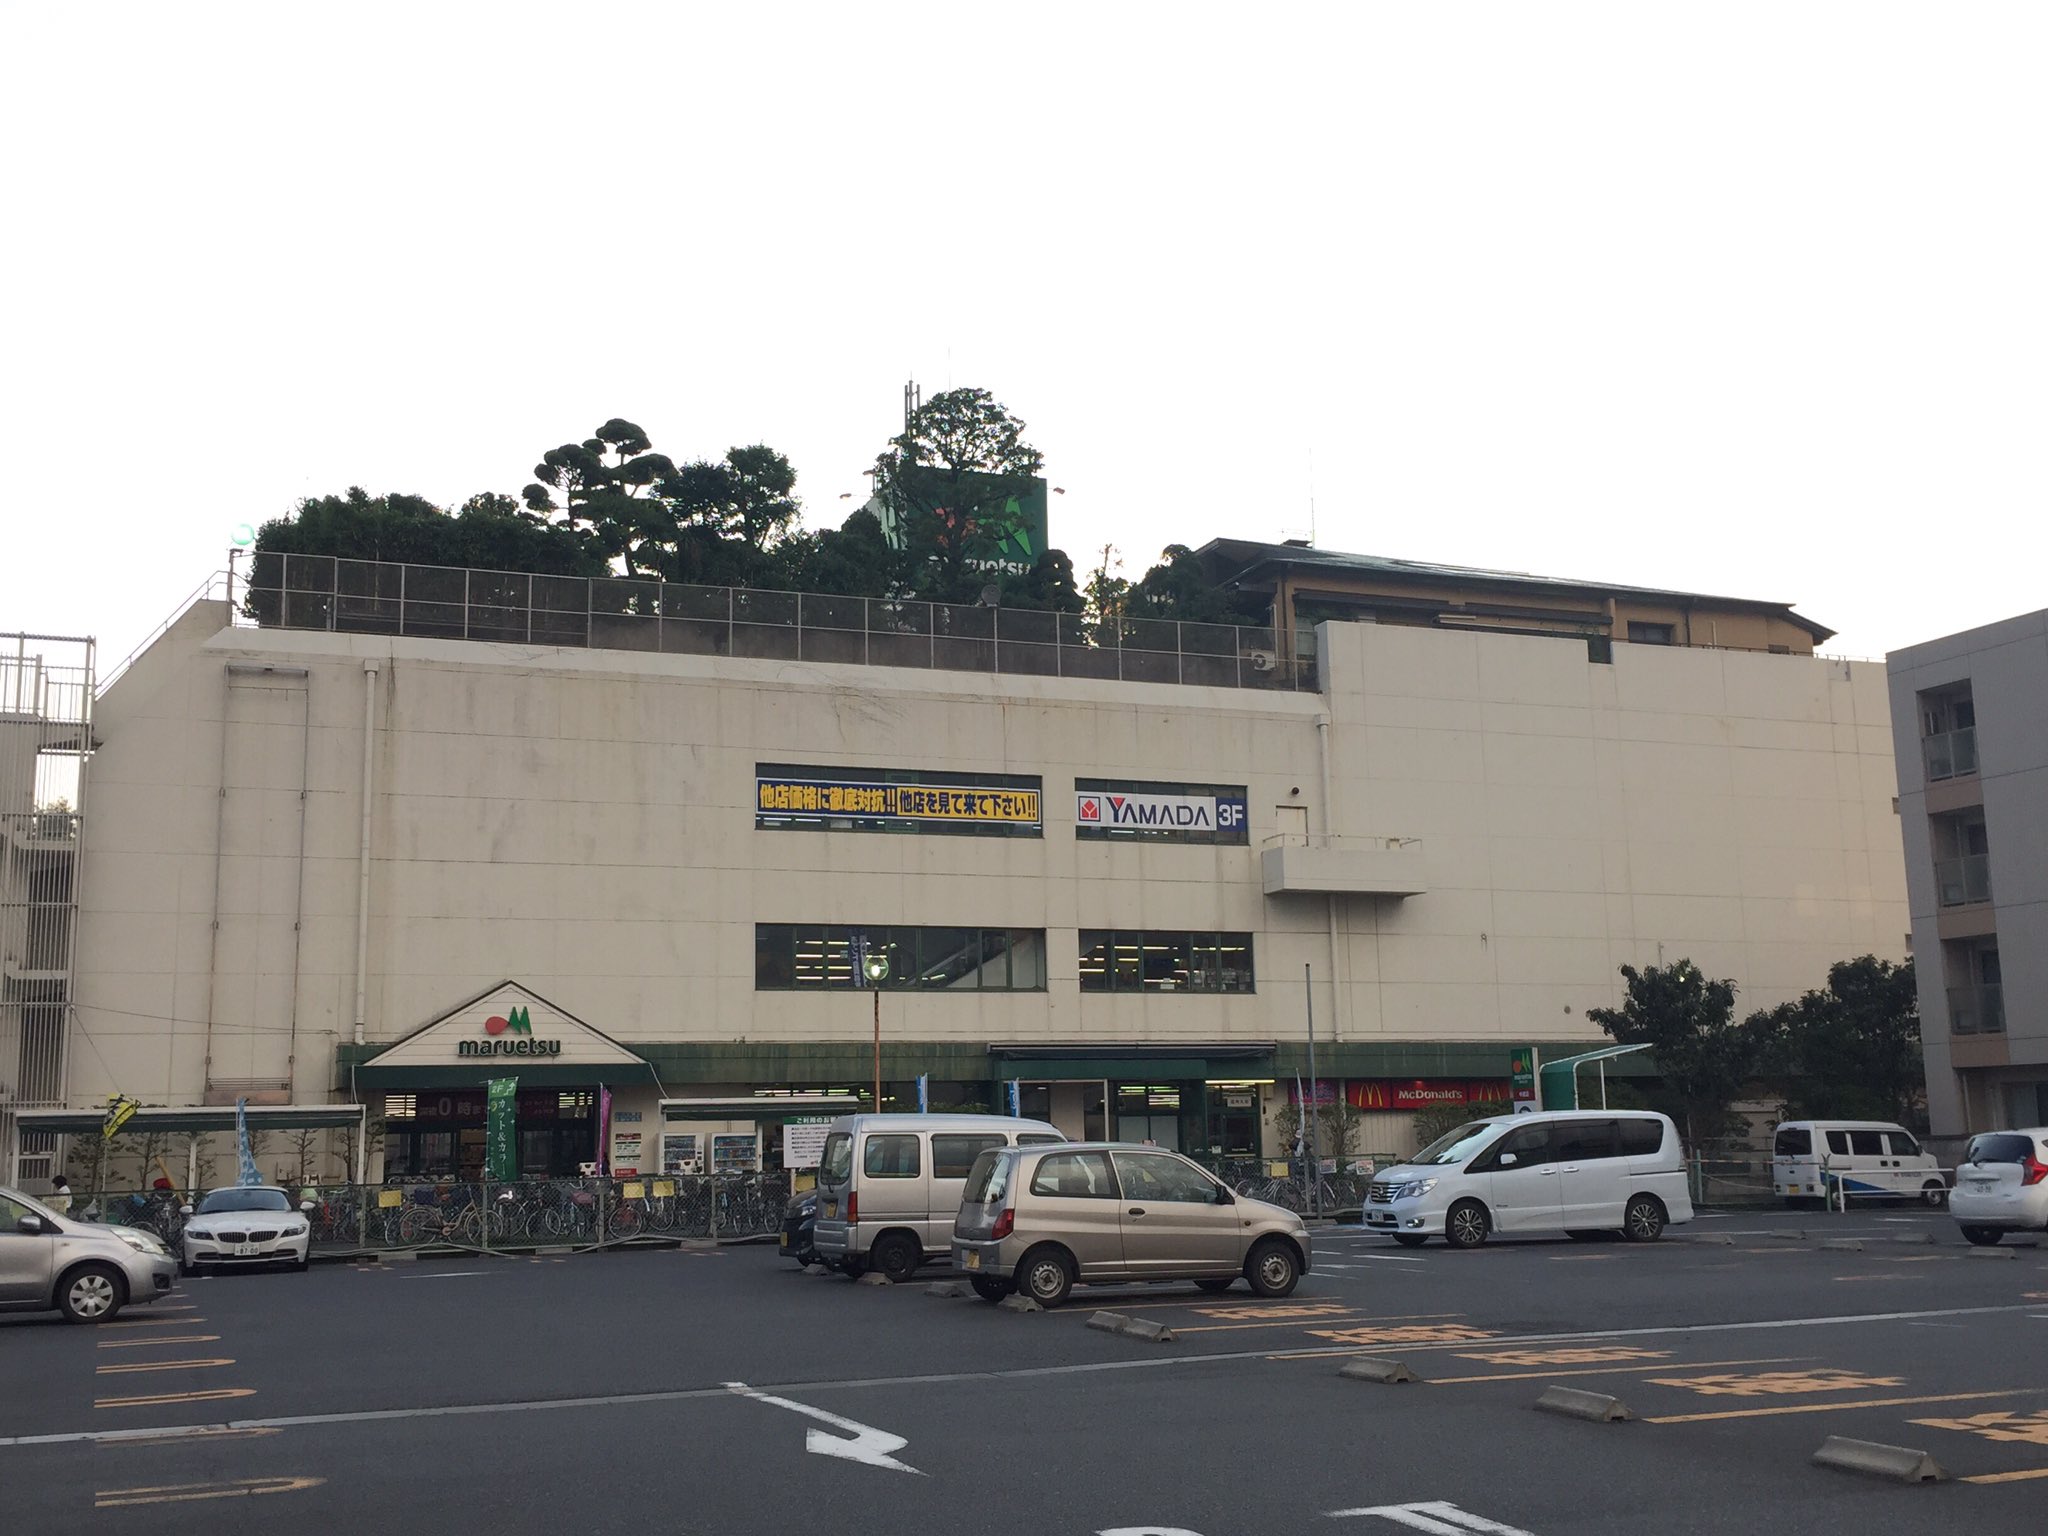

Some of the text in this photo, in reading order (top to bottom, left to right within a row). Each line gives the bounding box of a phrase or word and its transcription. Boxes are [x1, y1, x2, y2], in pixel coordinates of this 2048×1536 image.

[900, 789, 1036, 818] 他店を見て来て下さい!!
[1106, 797, 1243, 827] YAMADA 3F
[458, 1038, 561, 1057] maruetsu
[491, 1085, 504, 1094] 2F
[1398, 1089, 1463, 1100] McDonald's
[498, 1099, 506, 1176] カット&カラー
